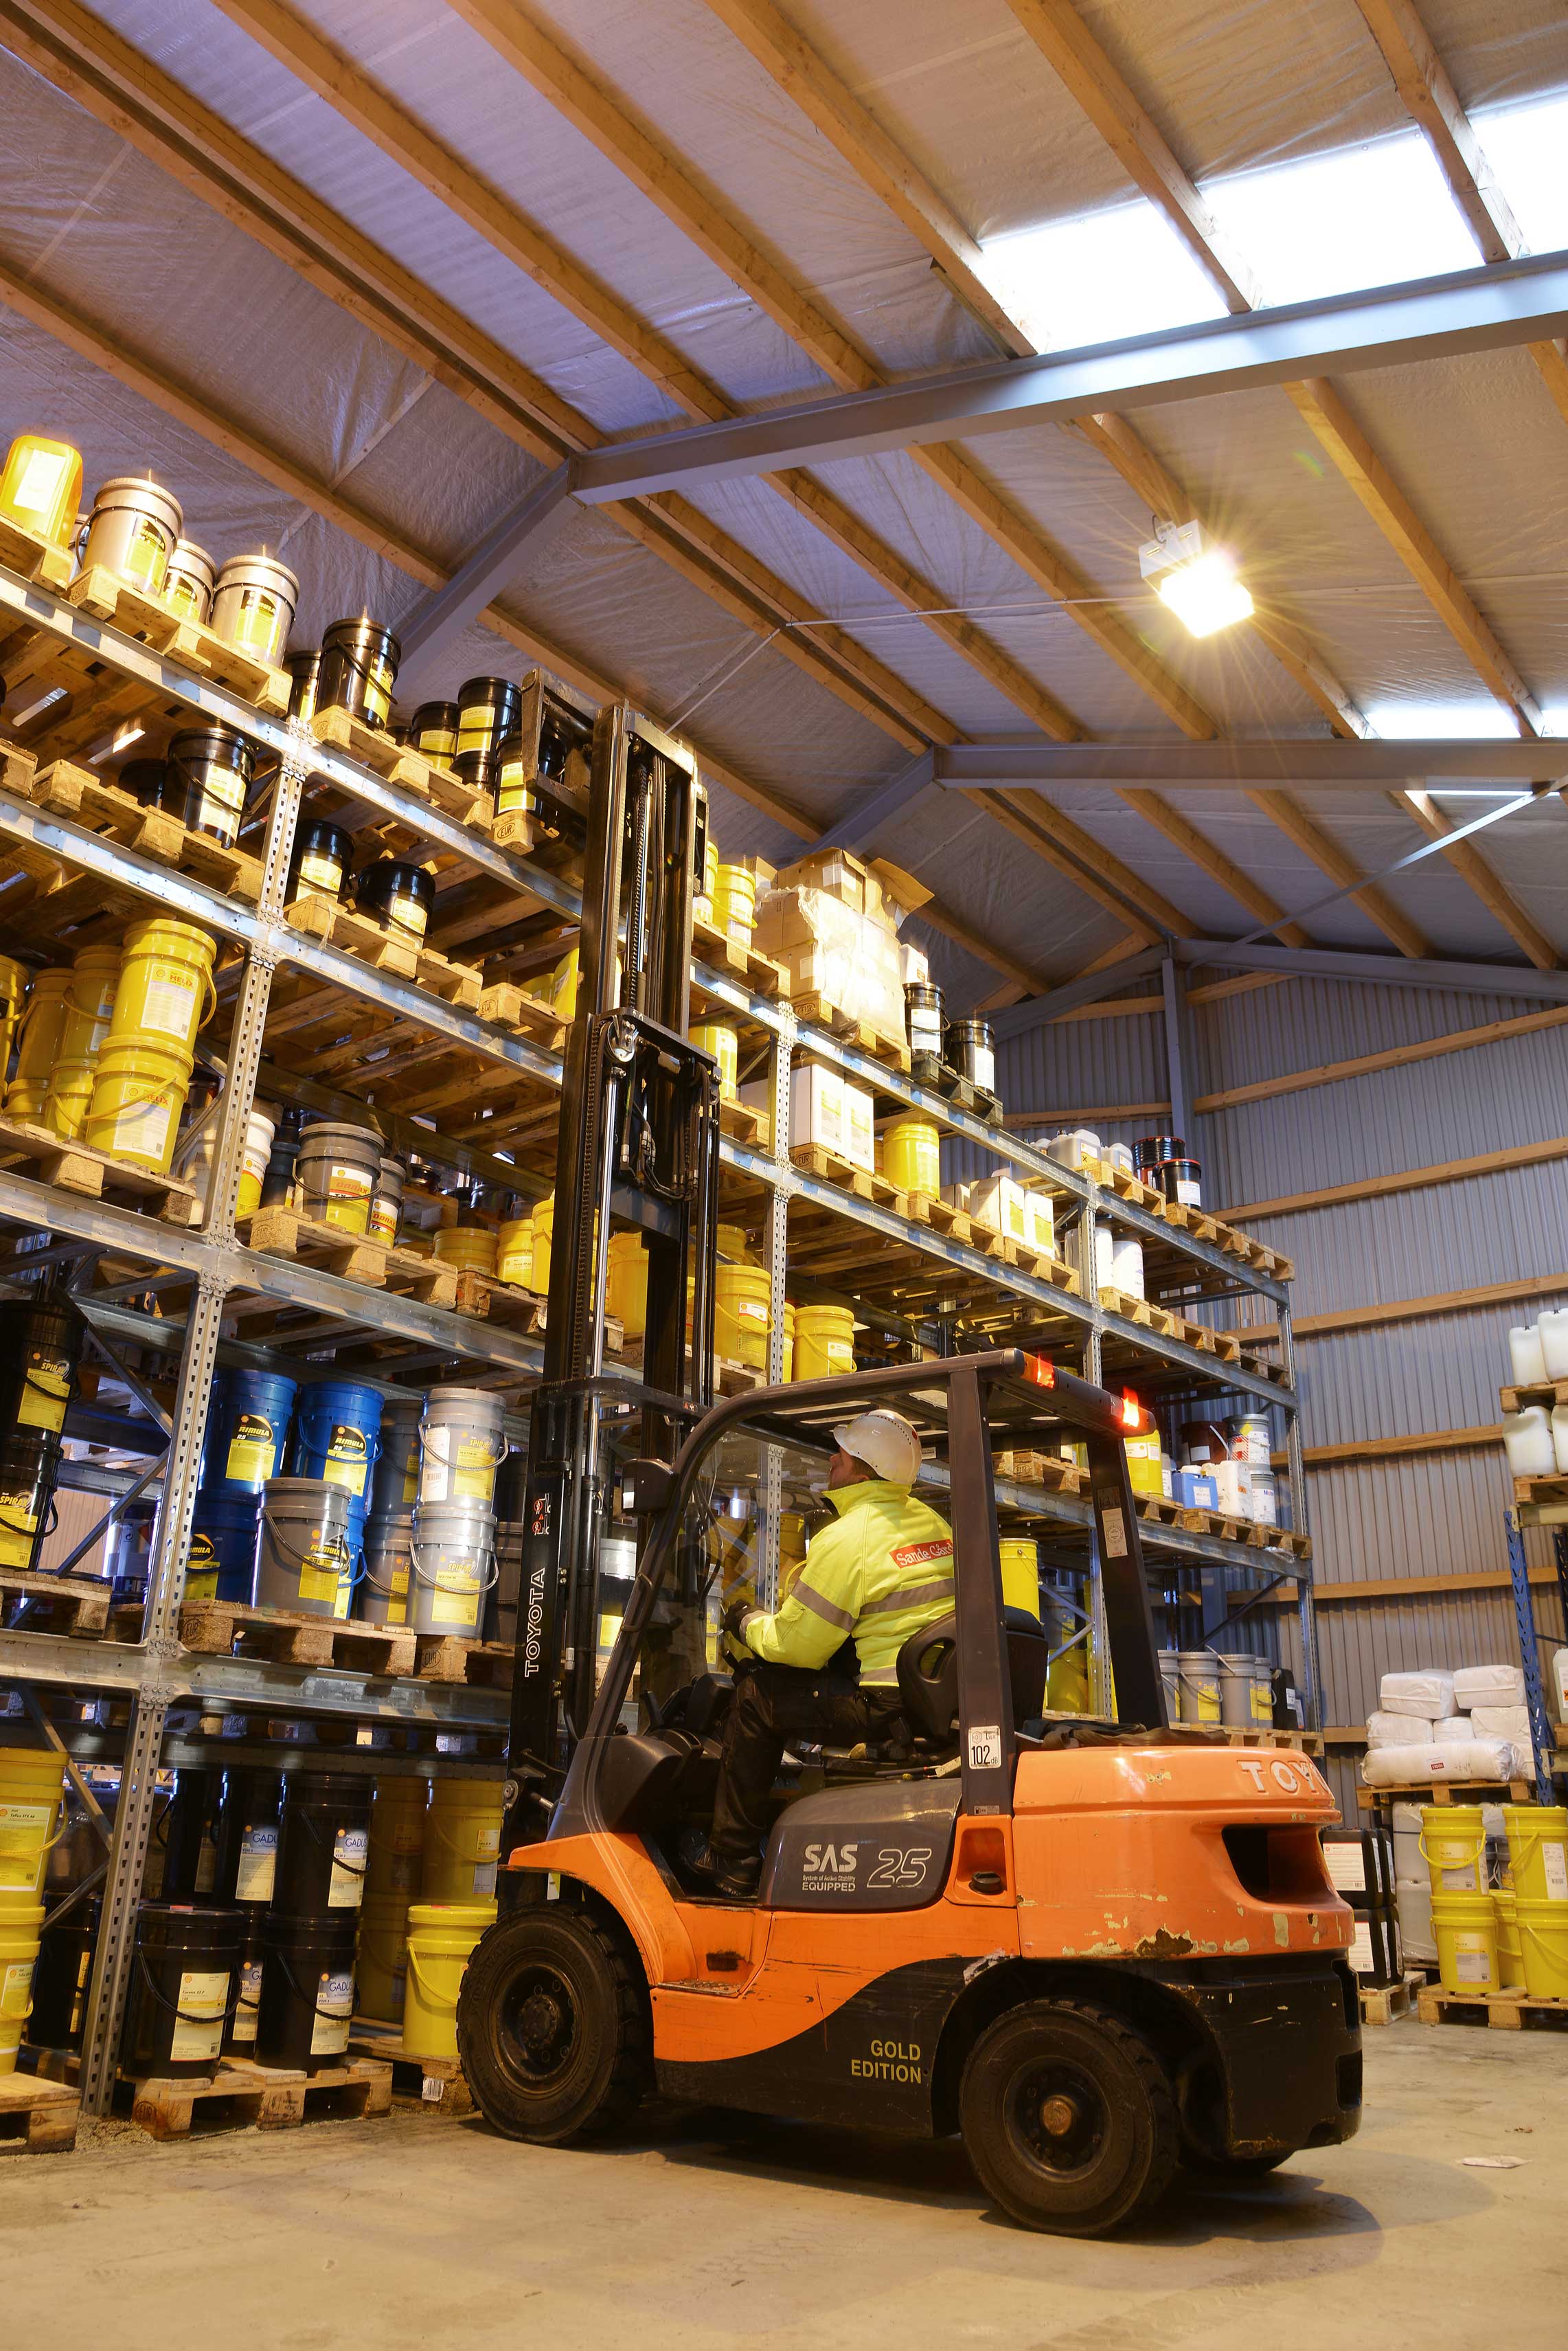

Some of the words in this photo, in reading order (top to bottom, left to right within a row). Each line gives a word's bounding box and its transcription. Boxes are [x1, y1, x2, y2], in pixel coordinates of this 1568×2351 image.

[501, 824, 512, 836] EUR
[170, 974, 194, 988] HELIX
[798, 1155, 809, 1165] EUR
[335, 1181, 369, 1195] DONAX
[372, 1212, 396, 1227] DONAX
[41, 1361, 67, 1375] SPIRAX
[238, 1426, 270, 1437] RIMULA
[334, 1437, 364, 1449] RIMULA
[188, 1545, 212, 1554] IMULA
[310, 1543, 340, 1556] RIMULA
[896, 1548, 932, 1566] Sande
[447, 1563, 472, 1573] SPIRAX
[185, 1621, 198, 1637] EUR
[524, 1567, 545, 1678] TOYOTA
[971, 1745, 990, 1765] 102
[990, 1756, 999, 1764] dB
[345, 1837, 367, 1848] GADUS
[803, 1843, 859, 1873] SAS
[866, 1848, 933, 1889] 25
[802, 1882, 856, 1892] EQUIPPED
[329, 1981, 352, 1992] GADUS
[870, 2039, 921, 2061] GOLD
[851, 2058, 922, 2085] EDITION
